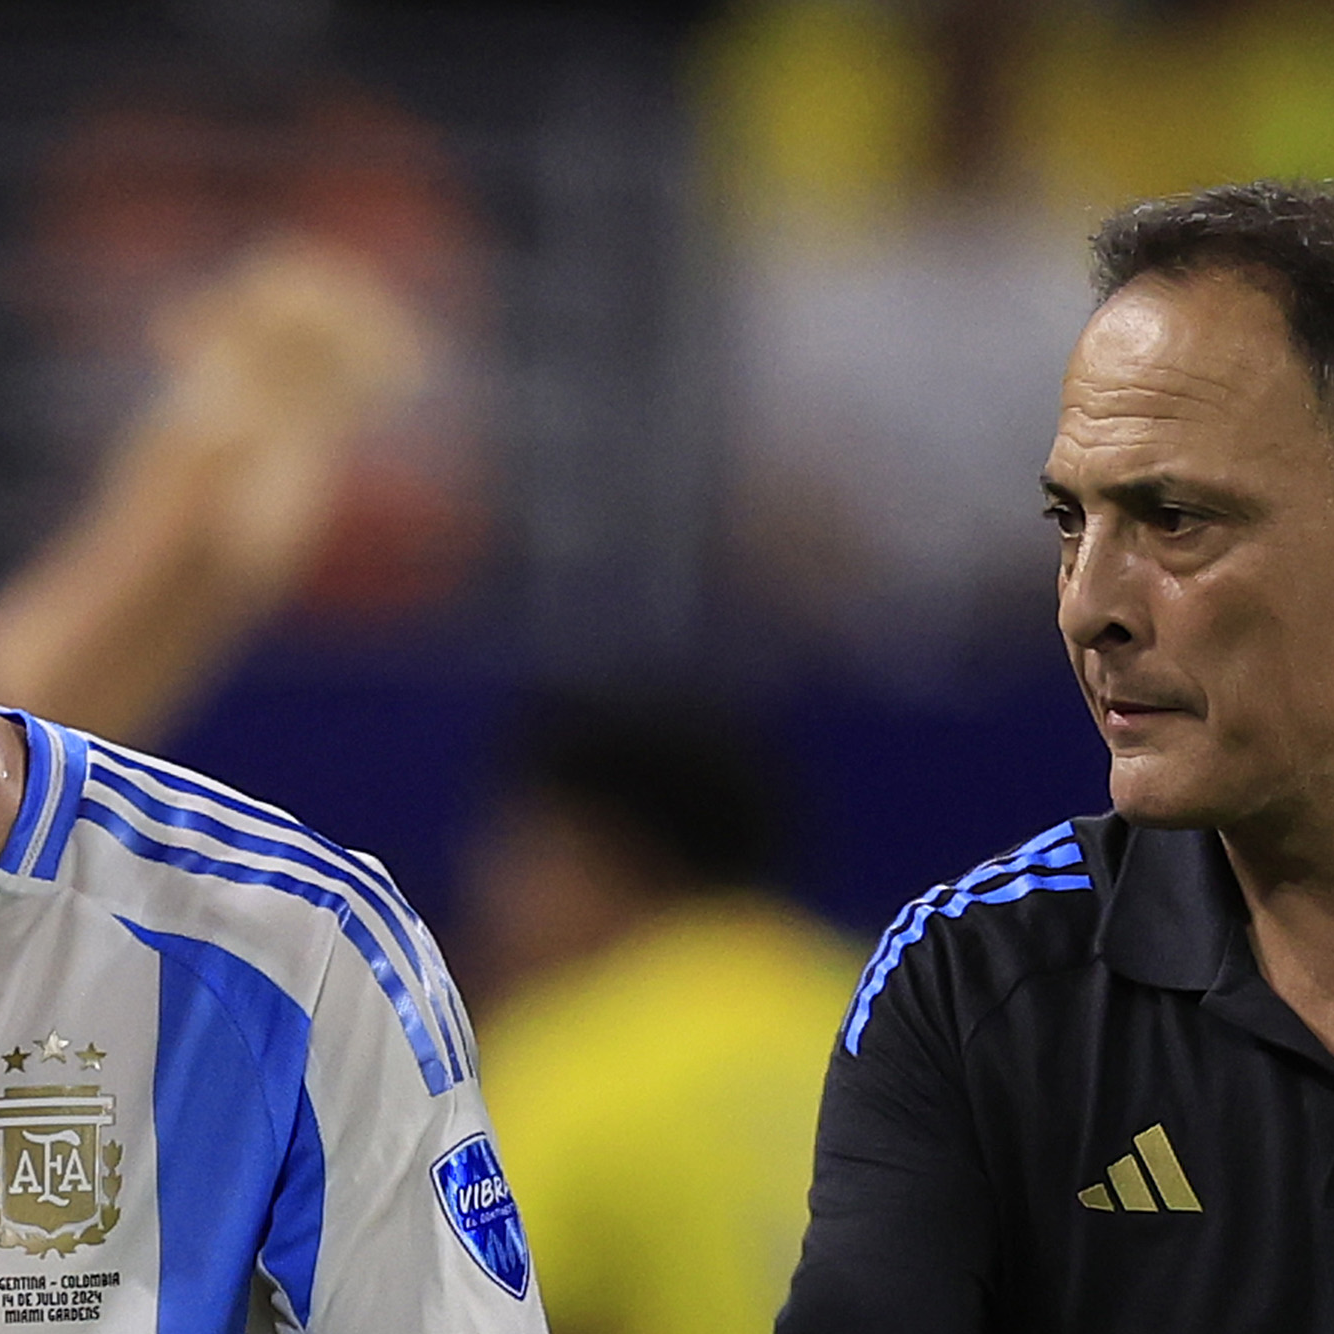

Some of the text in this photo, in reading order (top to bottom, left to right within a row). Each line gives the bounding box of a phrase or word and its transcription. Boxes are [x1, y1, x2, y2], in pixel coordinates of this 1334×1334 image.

[9, 1129, 93, 1207] AFA
[61, 1272, 120, 1289] COLOMBIA
[2, 1290, 102, 1307] 14 DE JULIO 2024
[5, 1305, 100, 1323] MIAMI GARDENS
